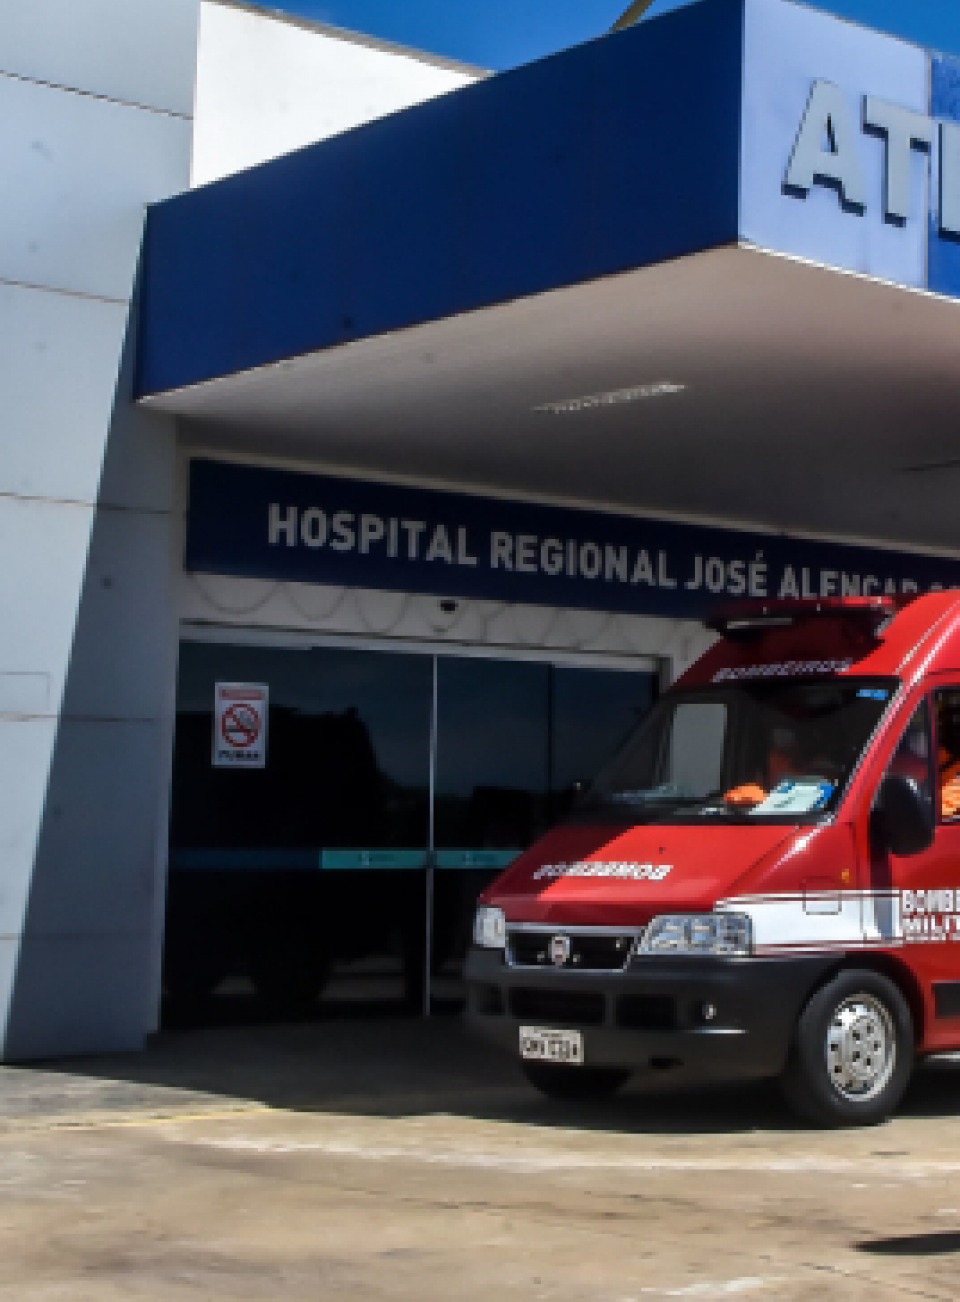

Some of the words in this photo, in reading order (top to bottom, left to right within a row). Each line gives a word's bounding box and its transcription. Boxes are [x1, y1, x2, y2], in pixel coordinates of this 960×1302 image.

[267, 503, 478, 566] HOSPITAL
[490, 531, 677, 589] REGIONAL
[686, 550, 768, 597] JOSÉ
